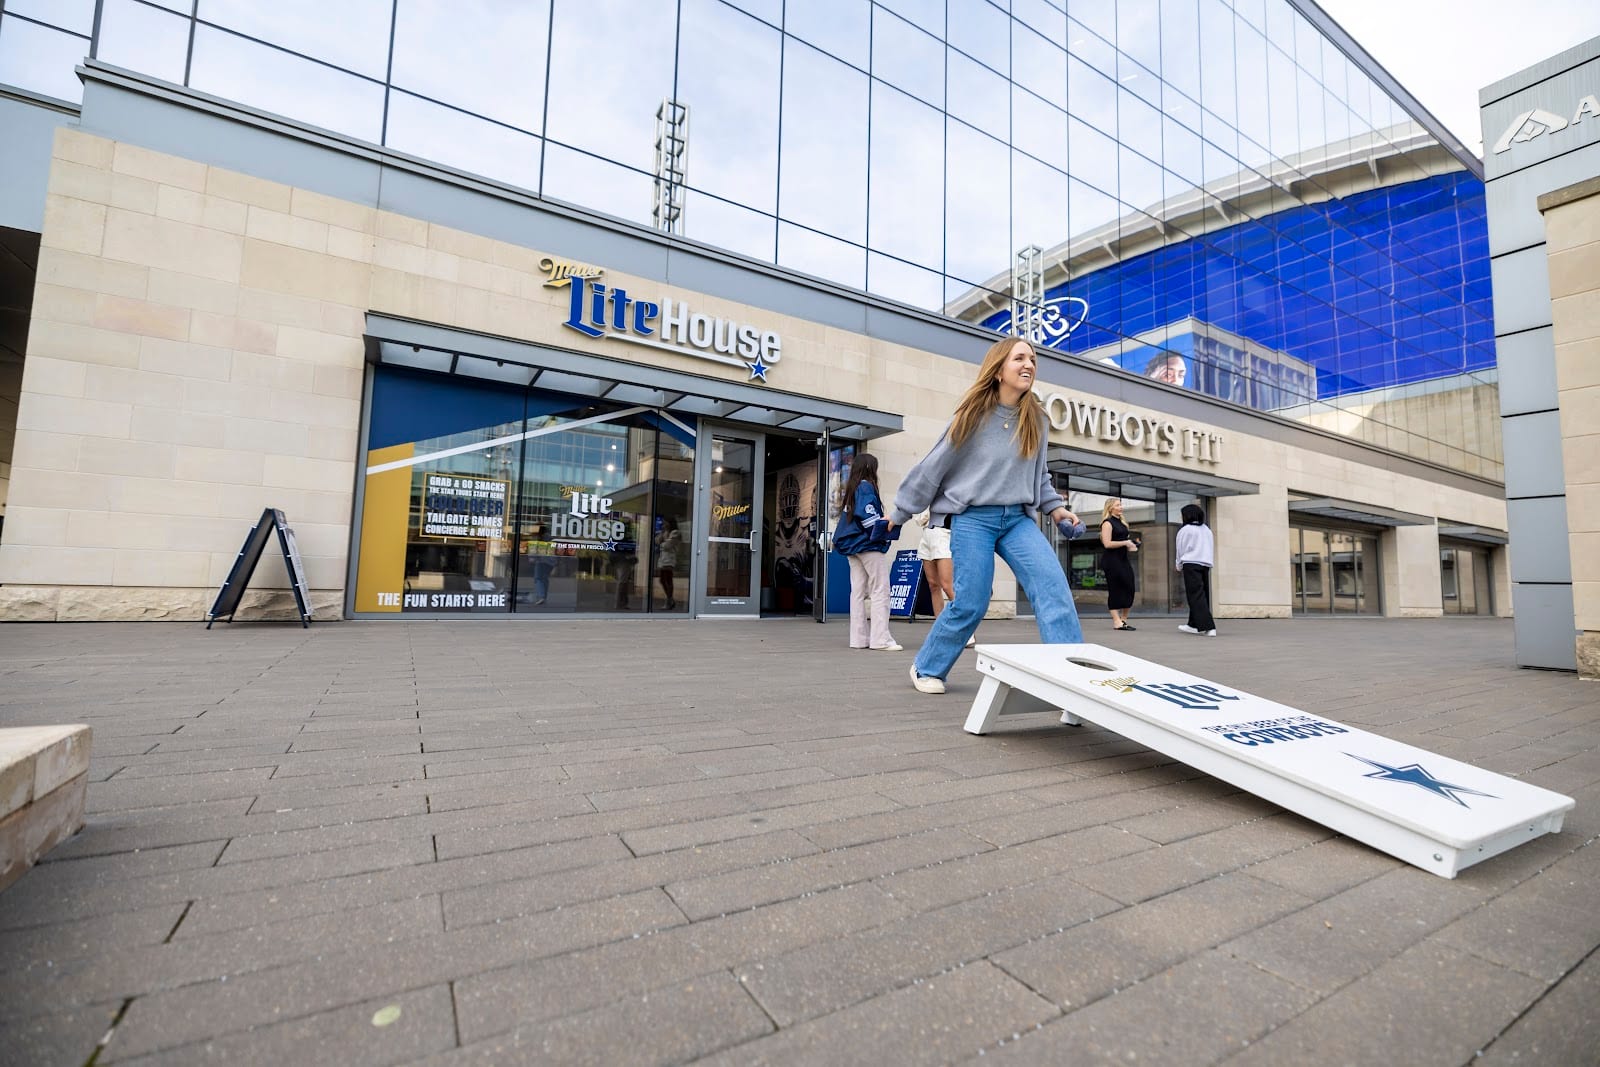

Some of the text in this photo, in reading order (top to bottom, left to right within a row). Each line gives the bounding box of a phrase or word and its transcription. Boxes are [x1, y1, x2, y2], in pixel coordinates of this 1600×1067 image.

[539, 257, 605, 287] Miller
[563, 275, 783, 364] Lite House
[1182, 427, 1225, 464] FIT
[430, 476, 506, 492] GRAB & GO SNACKS
[430, 486, 440, 494] THE
[428, 495, 503, 516] COLD BEER
[569, 491, 612, 519] Lite
[713, 504, 750, 520] Miller
[427, 512, 503, 527] TAILGATE GAMES
[551, 513, 625, 540] House
[425, 524, 503, 538] CONCIERGE & MORE!
[378, 592, 505, 607] THE FUN STARTS HERE
[890, 585, 911, 597] START
[890, 597, 907, 609] HERE
[1122, 683, 1240, 710] Lite
[1222, 721, 1350, 746] COWBOYS
